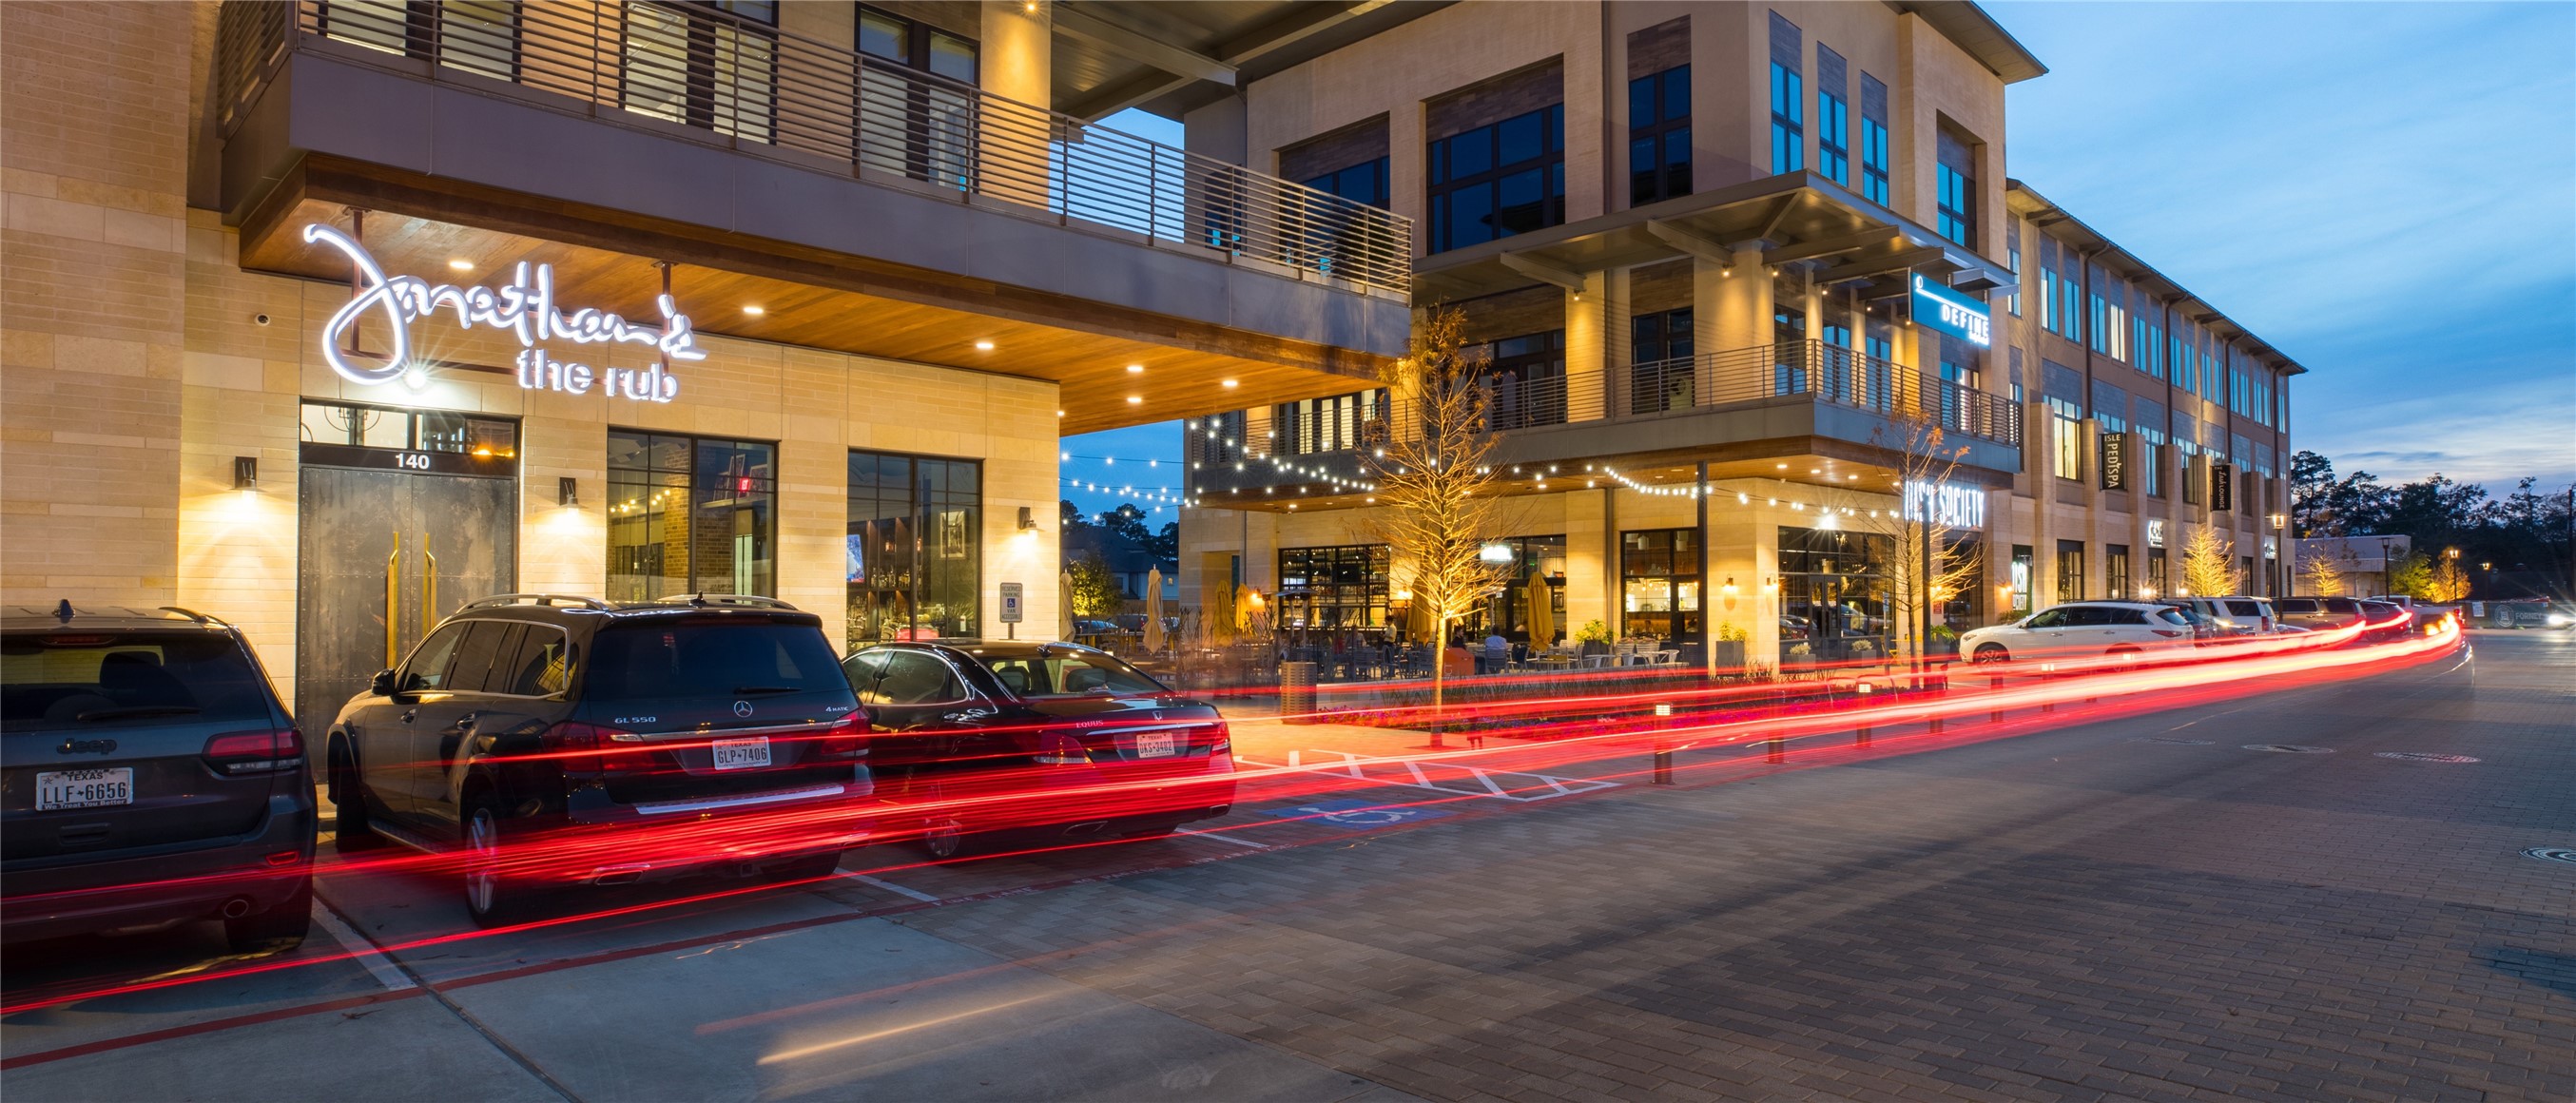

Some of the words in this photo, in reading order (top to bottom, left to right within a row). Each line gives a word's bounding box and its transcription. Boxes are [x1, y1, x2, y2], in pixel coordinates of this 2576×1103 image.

[303, 223, 707, 385] Jonathan's
[1942, 303, 1989, 338] DEFINE
[517, 348, 593, 394] the
[606, 363, 678, 403] rub
[2104, 434, 2121, 442] ISLE
[395, 453, 430, 470] 140
[1939, 484, 1985, 528] SOCIETY
[1075, 720, 1104, 728] EQUUS
[56, 738, 117, 755] Jeep
[68, 772, 104, 782] TEXAS
